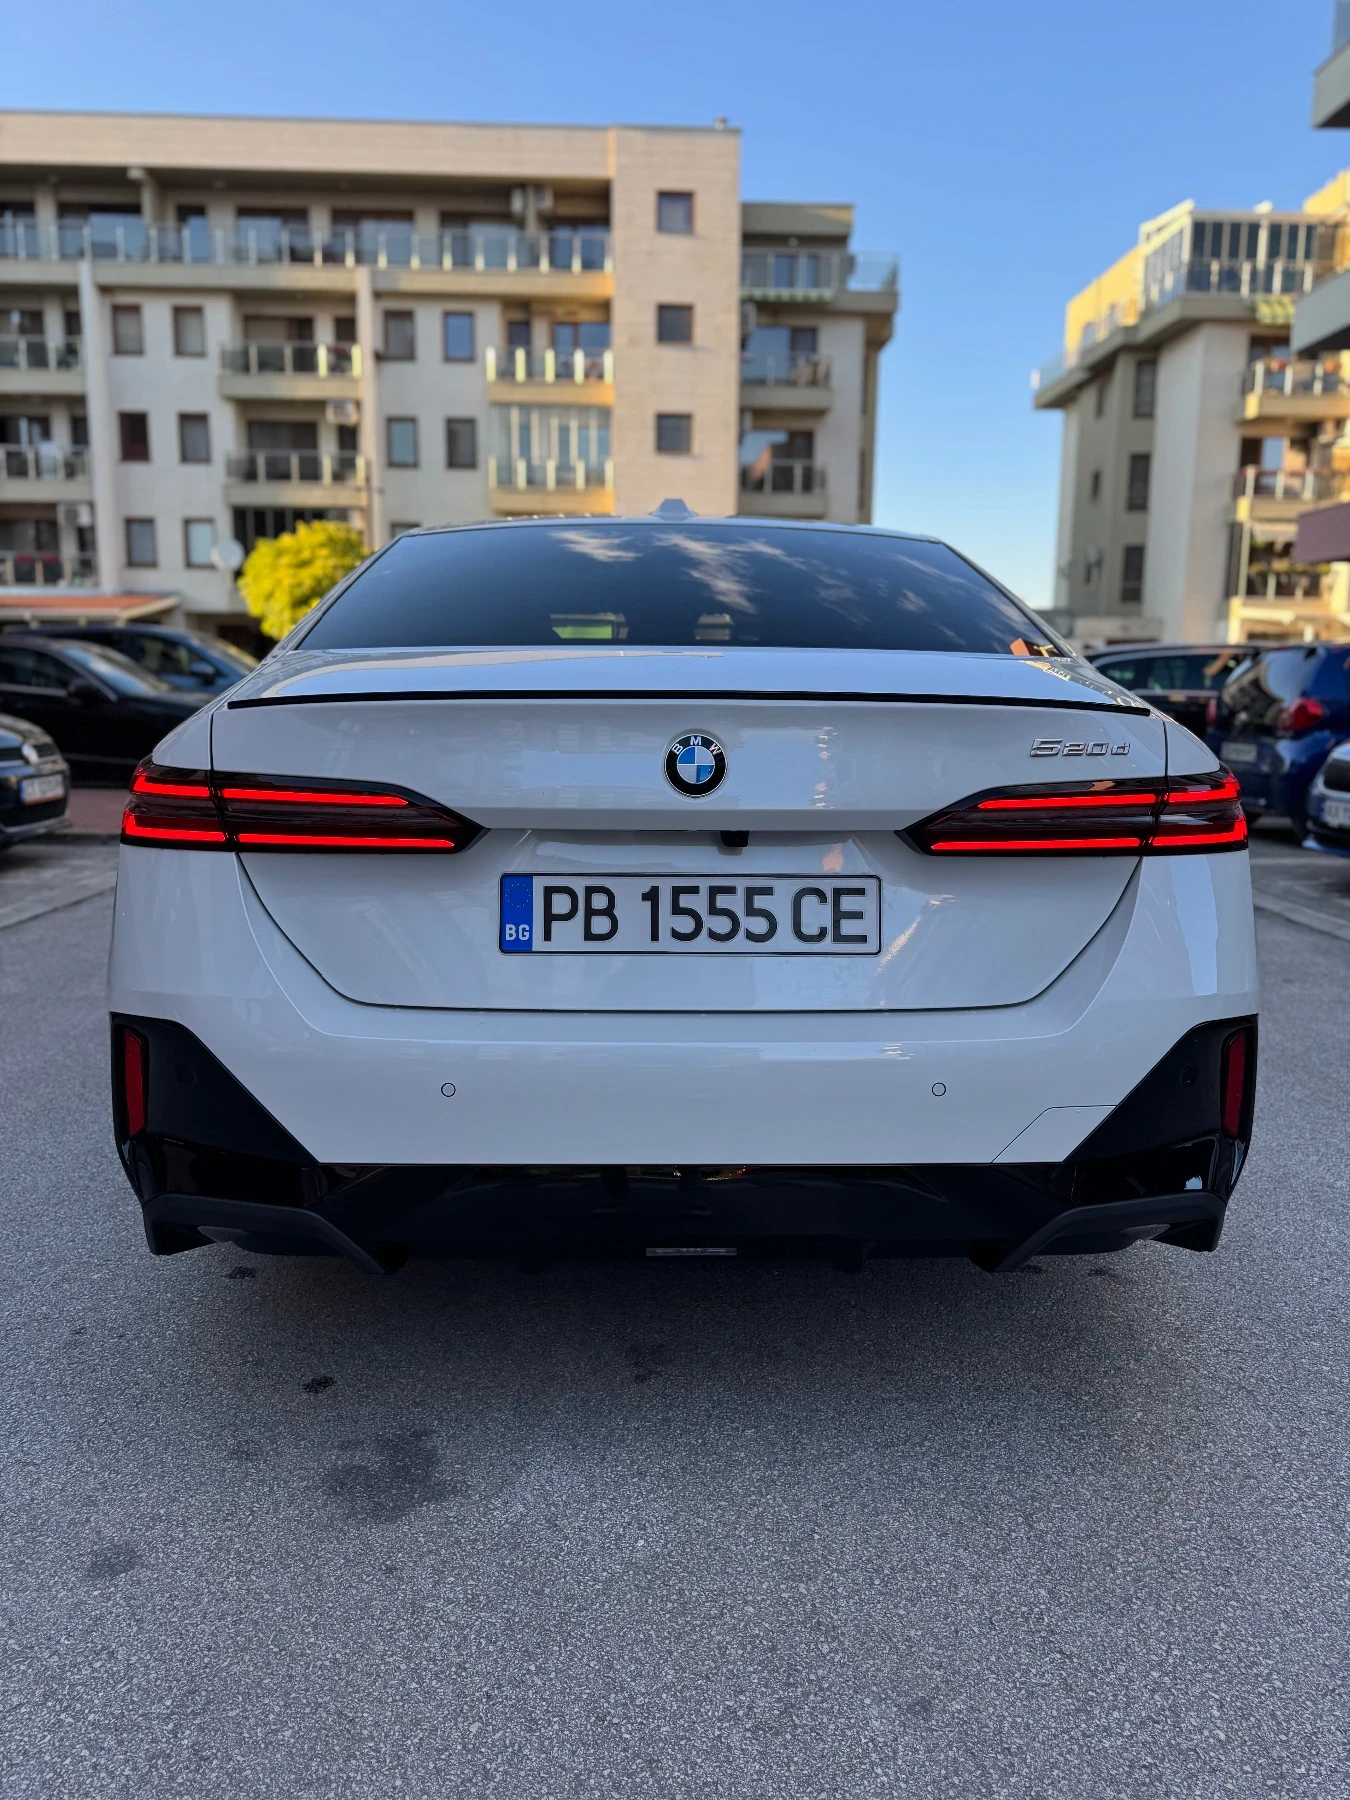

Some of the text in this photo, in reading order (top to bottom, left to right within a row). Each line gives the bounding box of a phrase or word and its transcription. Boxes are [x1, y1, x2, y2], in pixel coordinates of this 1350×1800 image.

[671, 735, 721, 755] BMW
[1030, 738, 1131, 757] 520d
[542, 885, 869, 943] PB 1555 CE
[505, 924, 530, 941] BG
